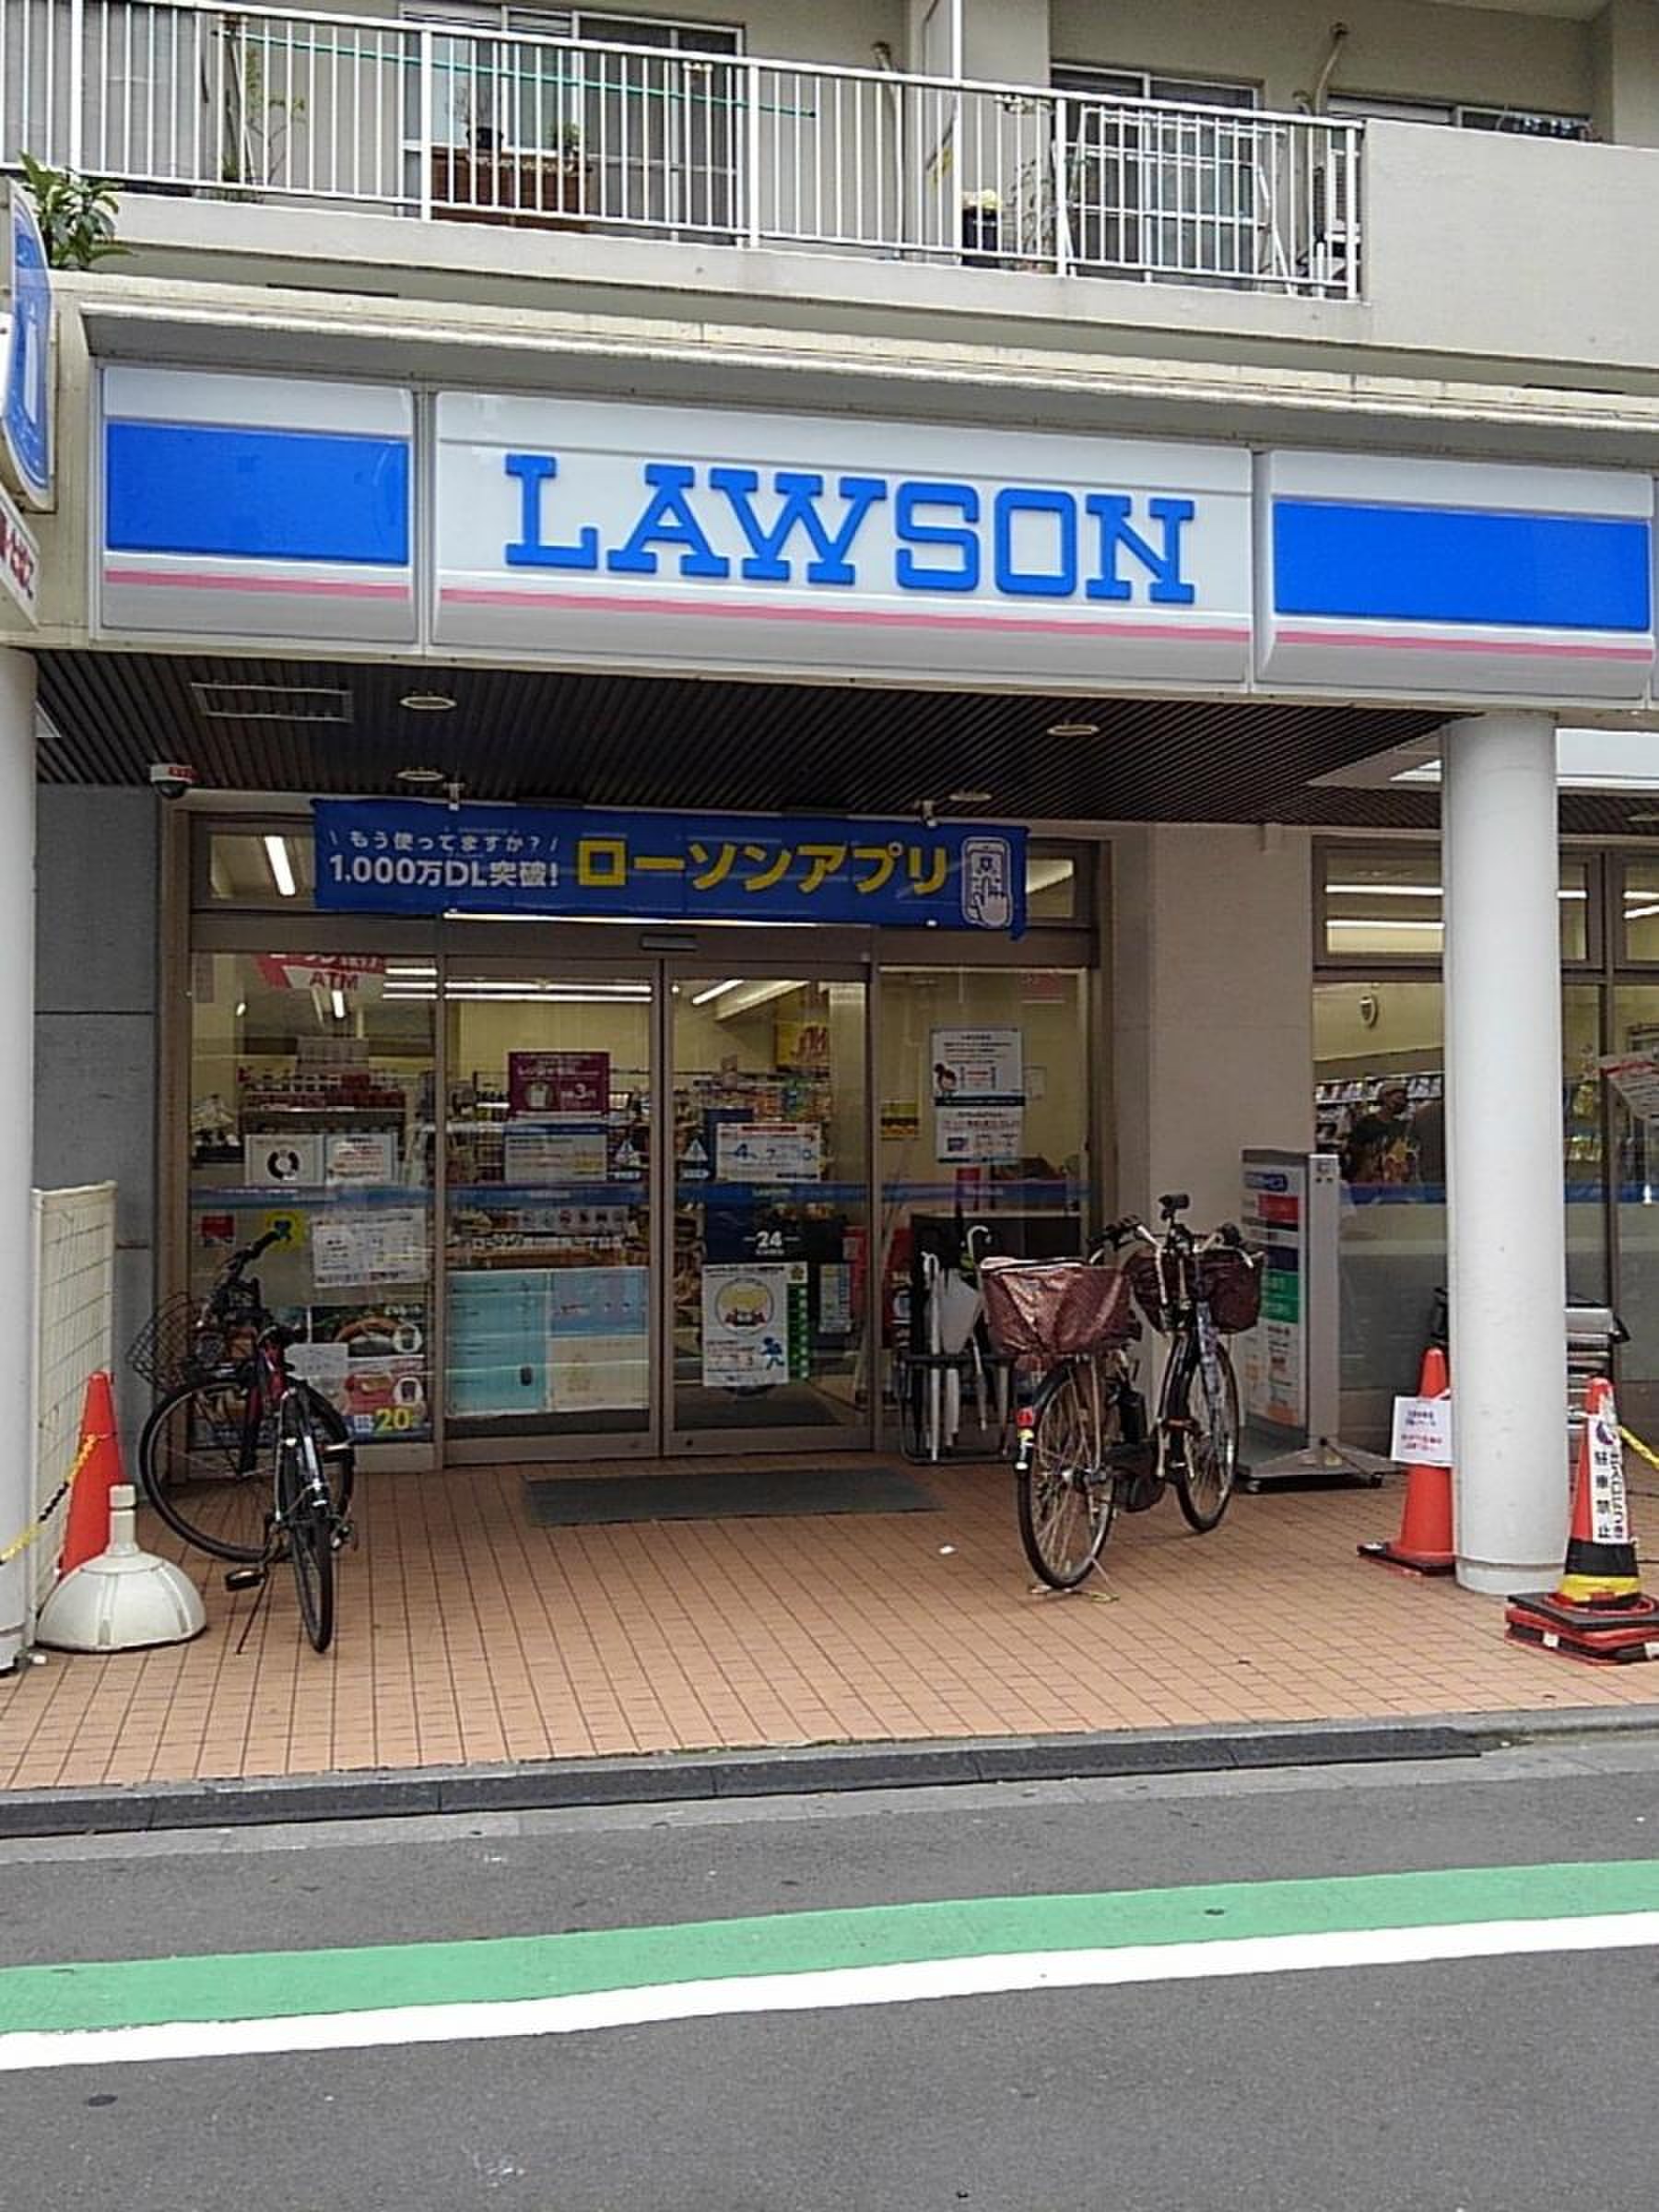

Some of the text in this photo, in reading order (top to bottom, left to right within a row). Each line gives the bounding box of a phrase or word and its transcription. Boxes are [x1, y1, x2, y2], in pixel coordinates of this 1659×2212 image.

[505, 453, 1195, 604] LAWSON
[578, 839, 947, 894] ローソンアプリ
[756, 1230, 782, 1247] 24
